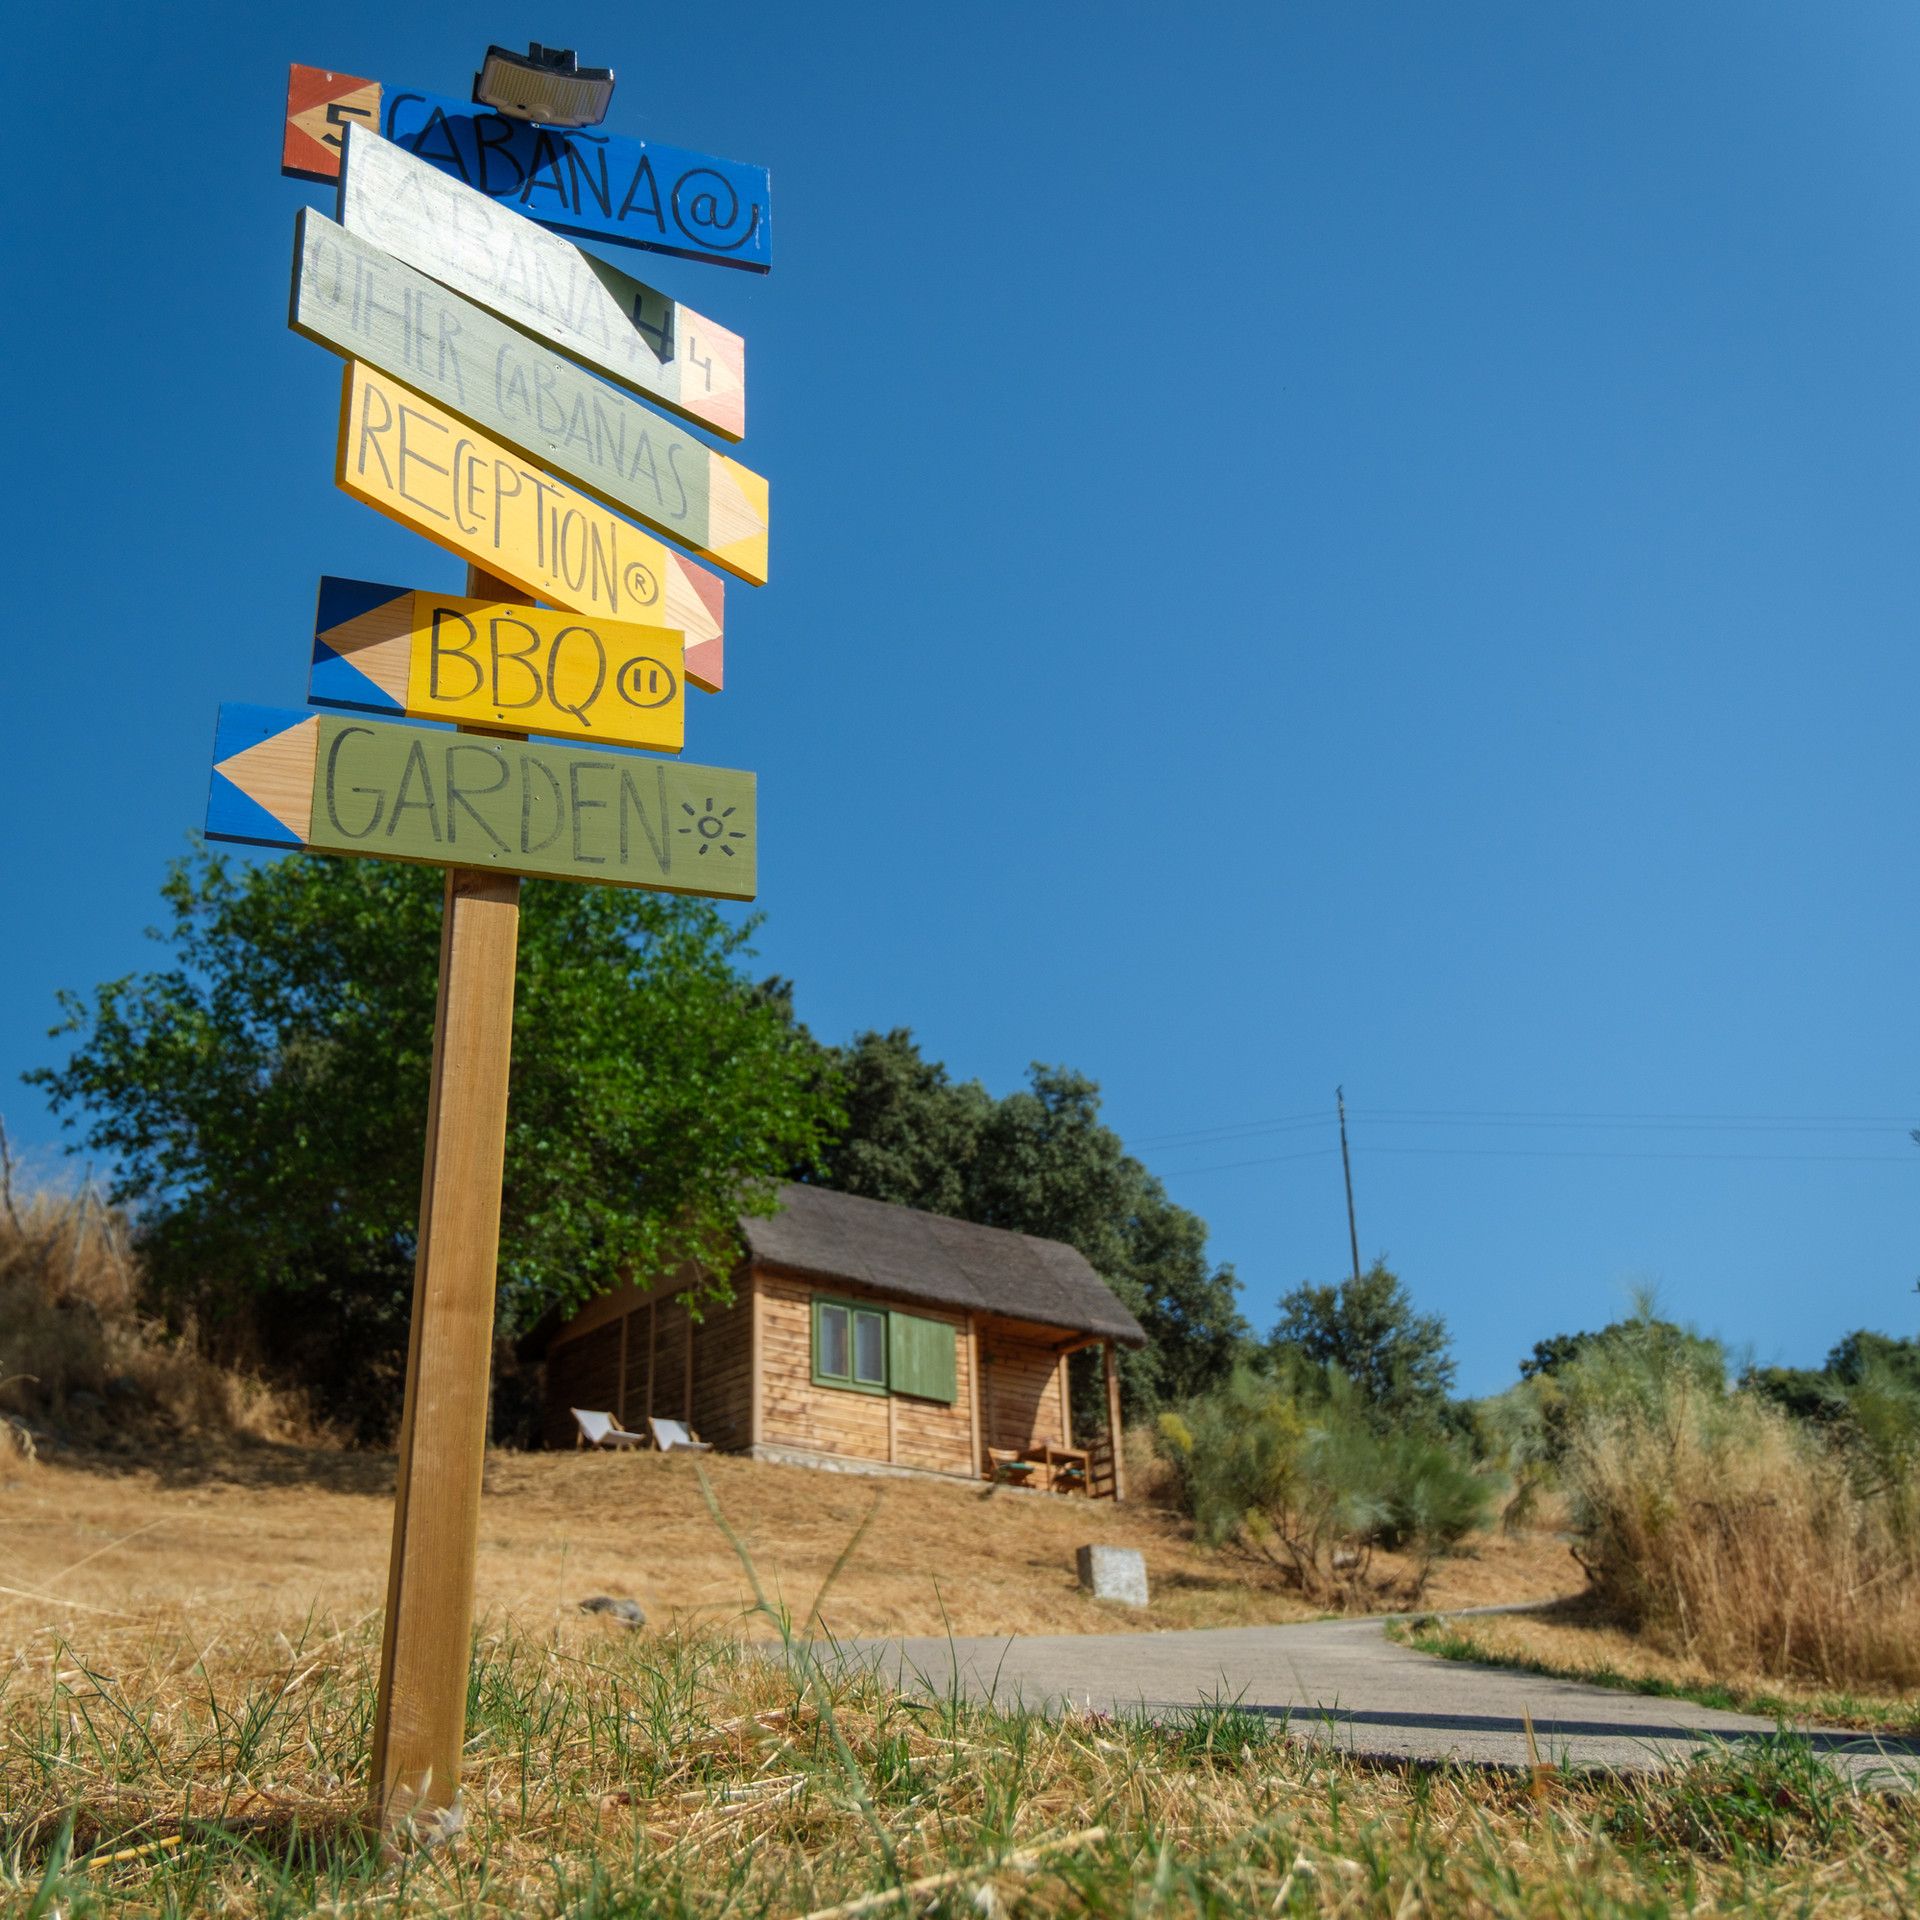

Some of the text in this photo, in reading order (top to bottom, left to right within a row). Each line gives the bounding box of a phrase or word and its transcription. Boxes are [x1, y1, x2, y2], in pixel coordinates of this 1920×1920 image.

[310, 235, 688, 520] OTHER CABAÑAS
[689, 336, 712, 392] 4
[429, 608, 607, 728] BBQ
[326, 726, 673, 875] GARDEN
